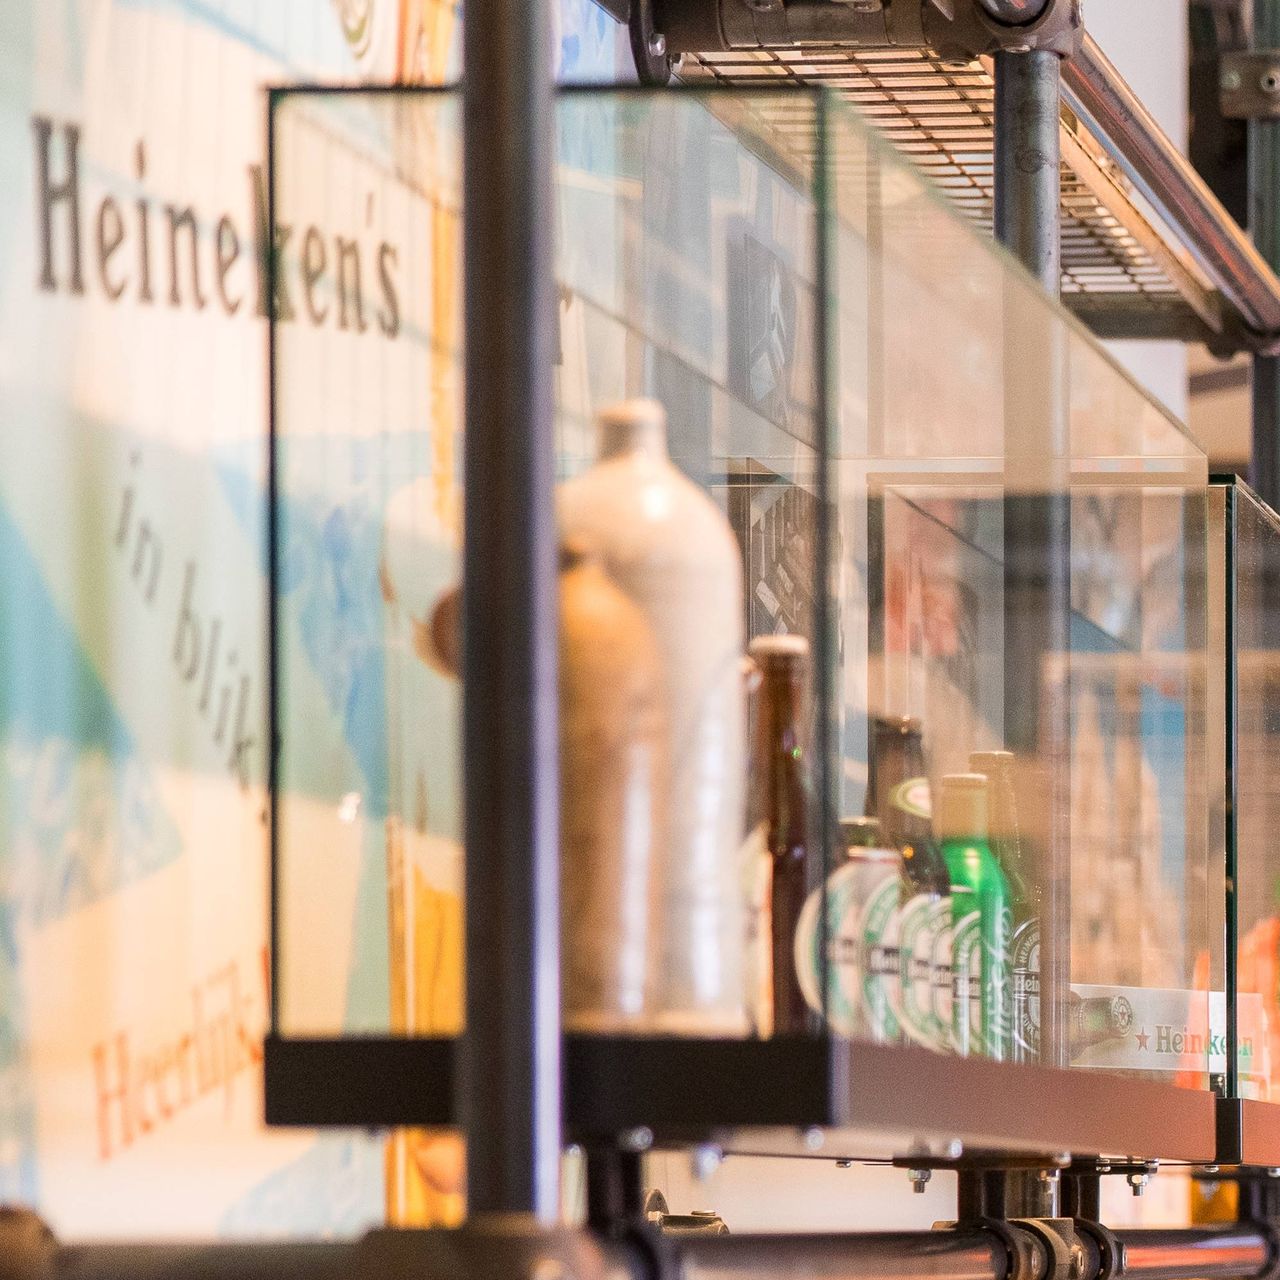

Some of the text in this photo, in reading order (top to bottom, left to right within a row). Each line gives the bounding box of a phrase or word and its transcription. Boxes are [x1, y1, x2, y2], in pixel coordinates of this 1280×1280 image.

[32, 115, 400, 340] Heineken's
[114, 450, 256, 797] in blik
